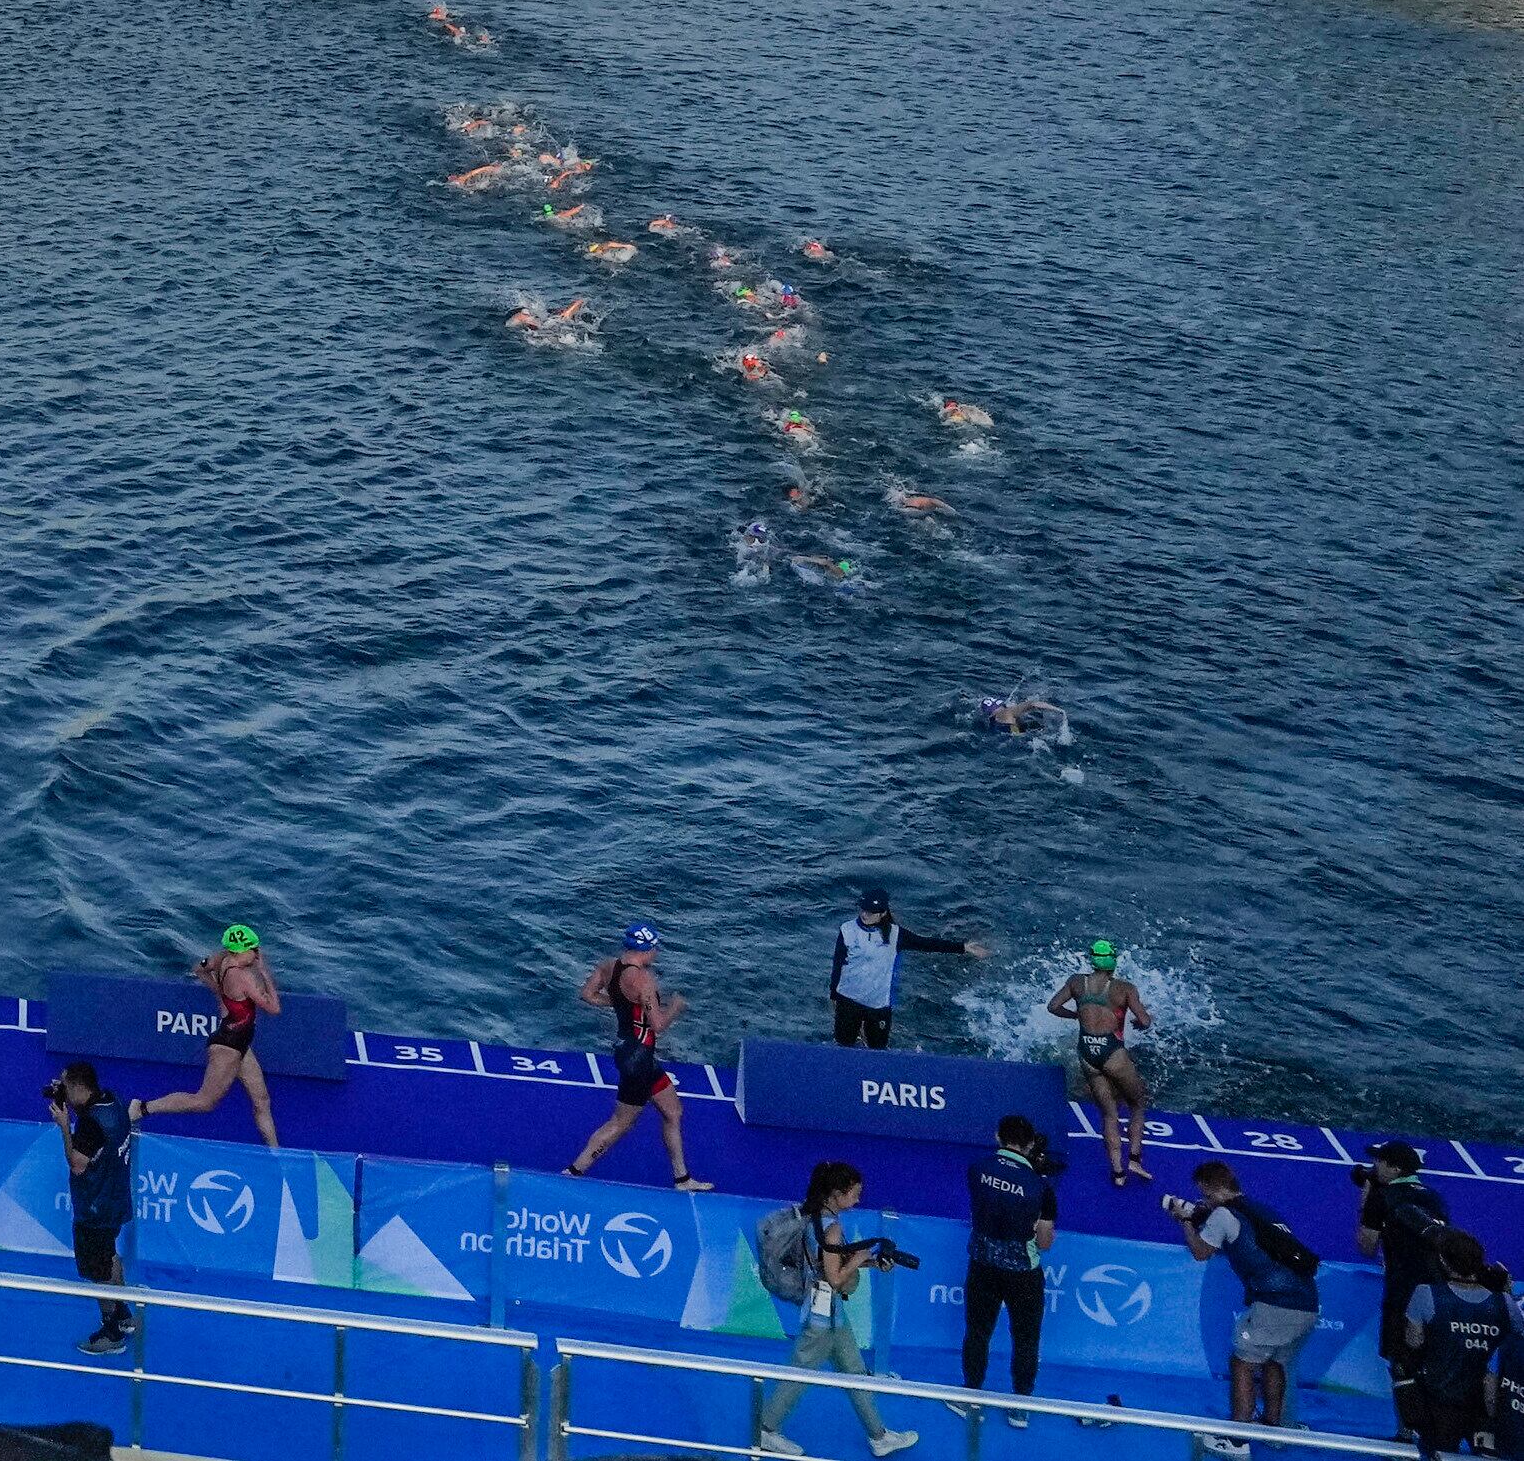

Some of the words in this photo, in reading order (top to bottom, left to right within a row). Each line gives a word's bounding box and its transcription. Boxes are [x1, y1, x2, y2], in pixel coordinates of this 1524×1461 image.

[229, 930, 248, 944] 42
[157, 1010, 221, 1038] PARI
[394, 1045, 444, 1062] 35
[511, 1056, 563, 1074] 34
[862, 1080, 946, 1110] PARIS
[1243, 1131, 1303, 1150] 28
[980, 1173, 1025, 1197] MEDIA
[1450, 1321, 1500, 1336] PHOTO
[1465, 1338, 1489, 1351] 044
